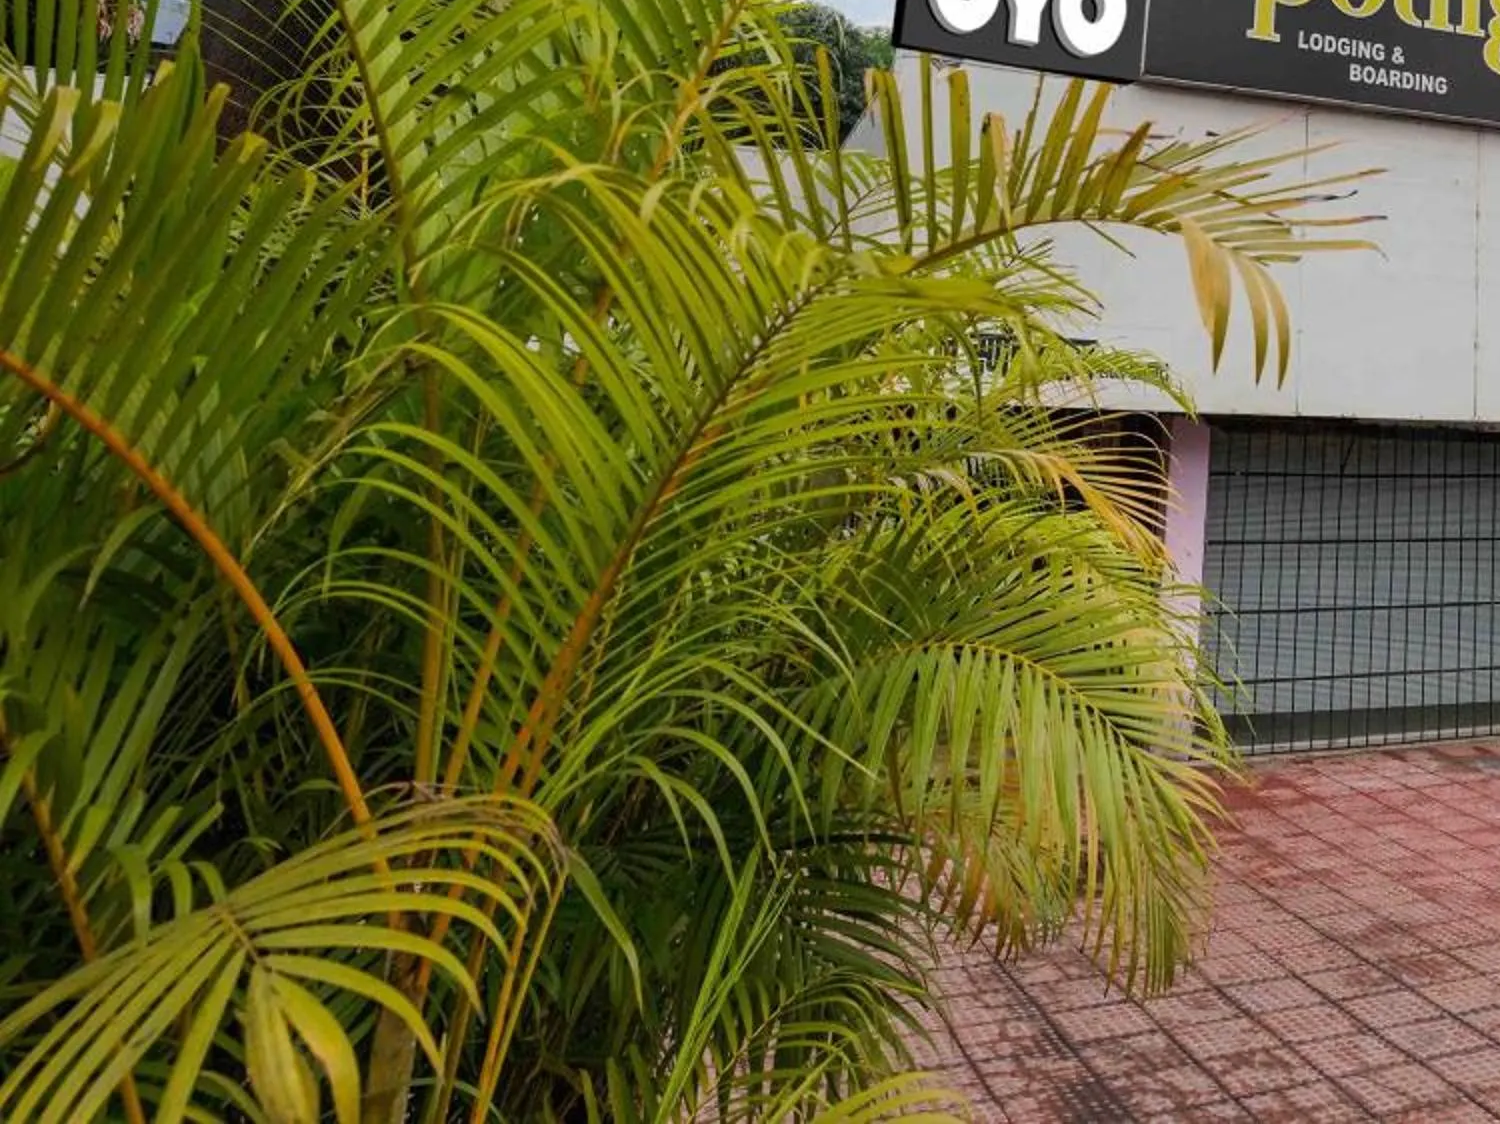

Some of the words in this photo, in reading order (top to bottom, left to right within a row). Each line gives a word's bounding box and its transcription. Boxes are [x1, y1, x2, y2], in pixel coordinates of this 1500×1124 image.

[1298, 30, 1385, 61] LODGING
[1391, 46, 1405, 64] &
[1349, 63, 1448, 95] BOARDING
